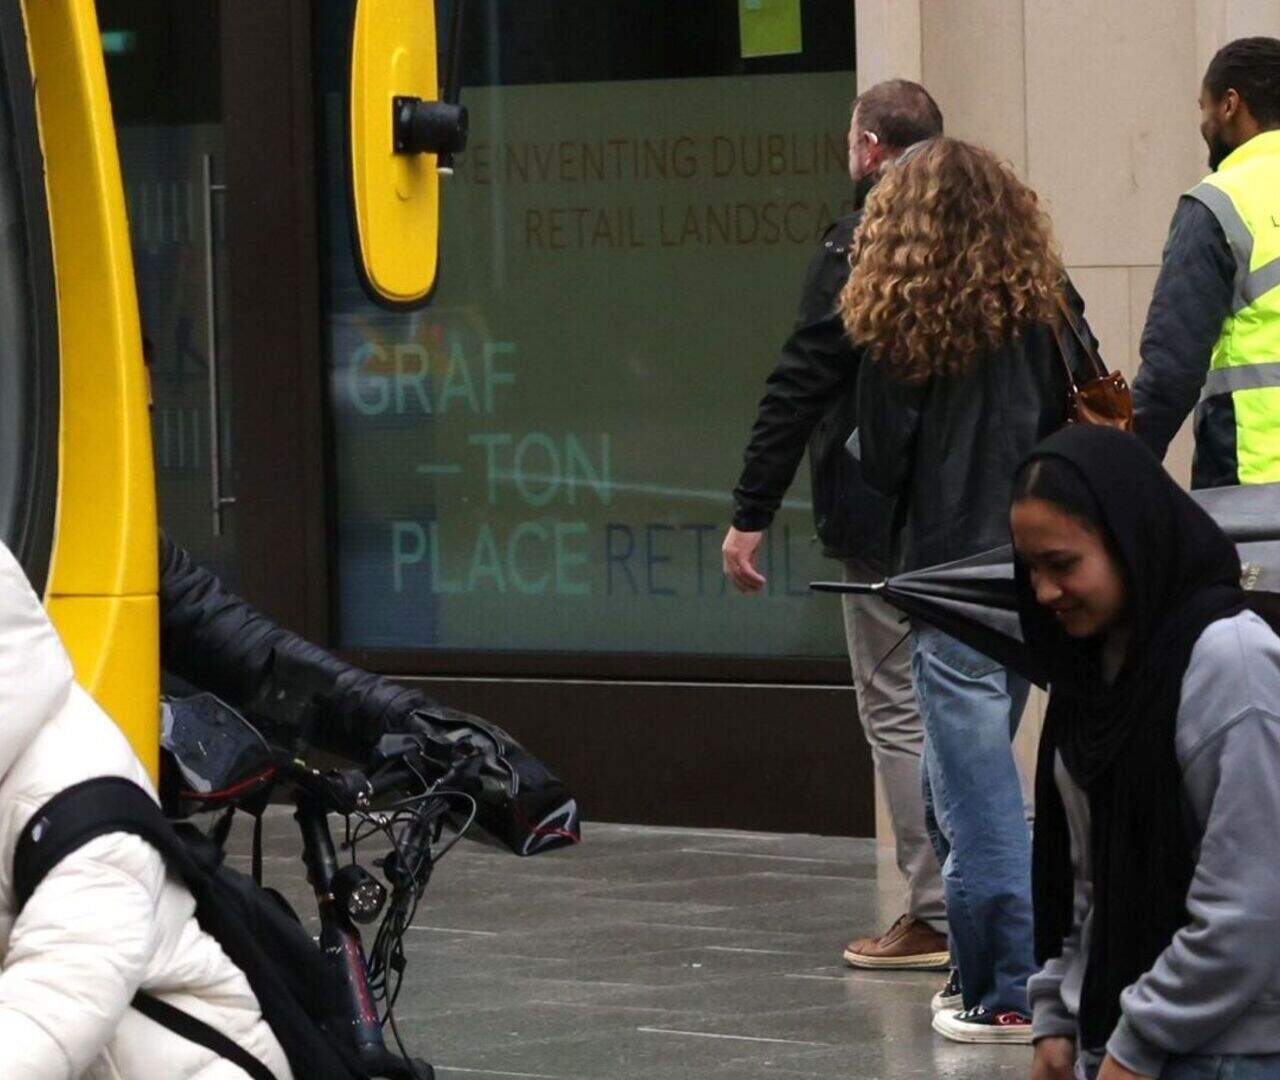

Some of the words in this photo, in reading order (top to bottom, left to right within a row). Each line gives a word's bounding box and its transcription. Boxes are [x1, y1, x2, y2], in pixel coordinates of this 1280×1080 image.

[711, 131, 849, 179] DUBLIN
[525, 205, 646, 251] RETAIL
[658, 199, 854, 248] LANDSCA
[347, 340, 518, 416] GRAF
[392, 520, 591, 597] PLACE
[604, 520, 816, 598] RETIL
